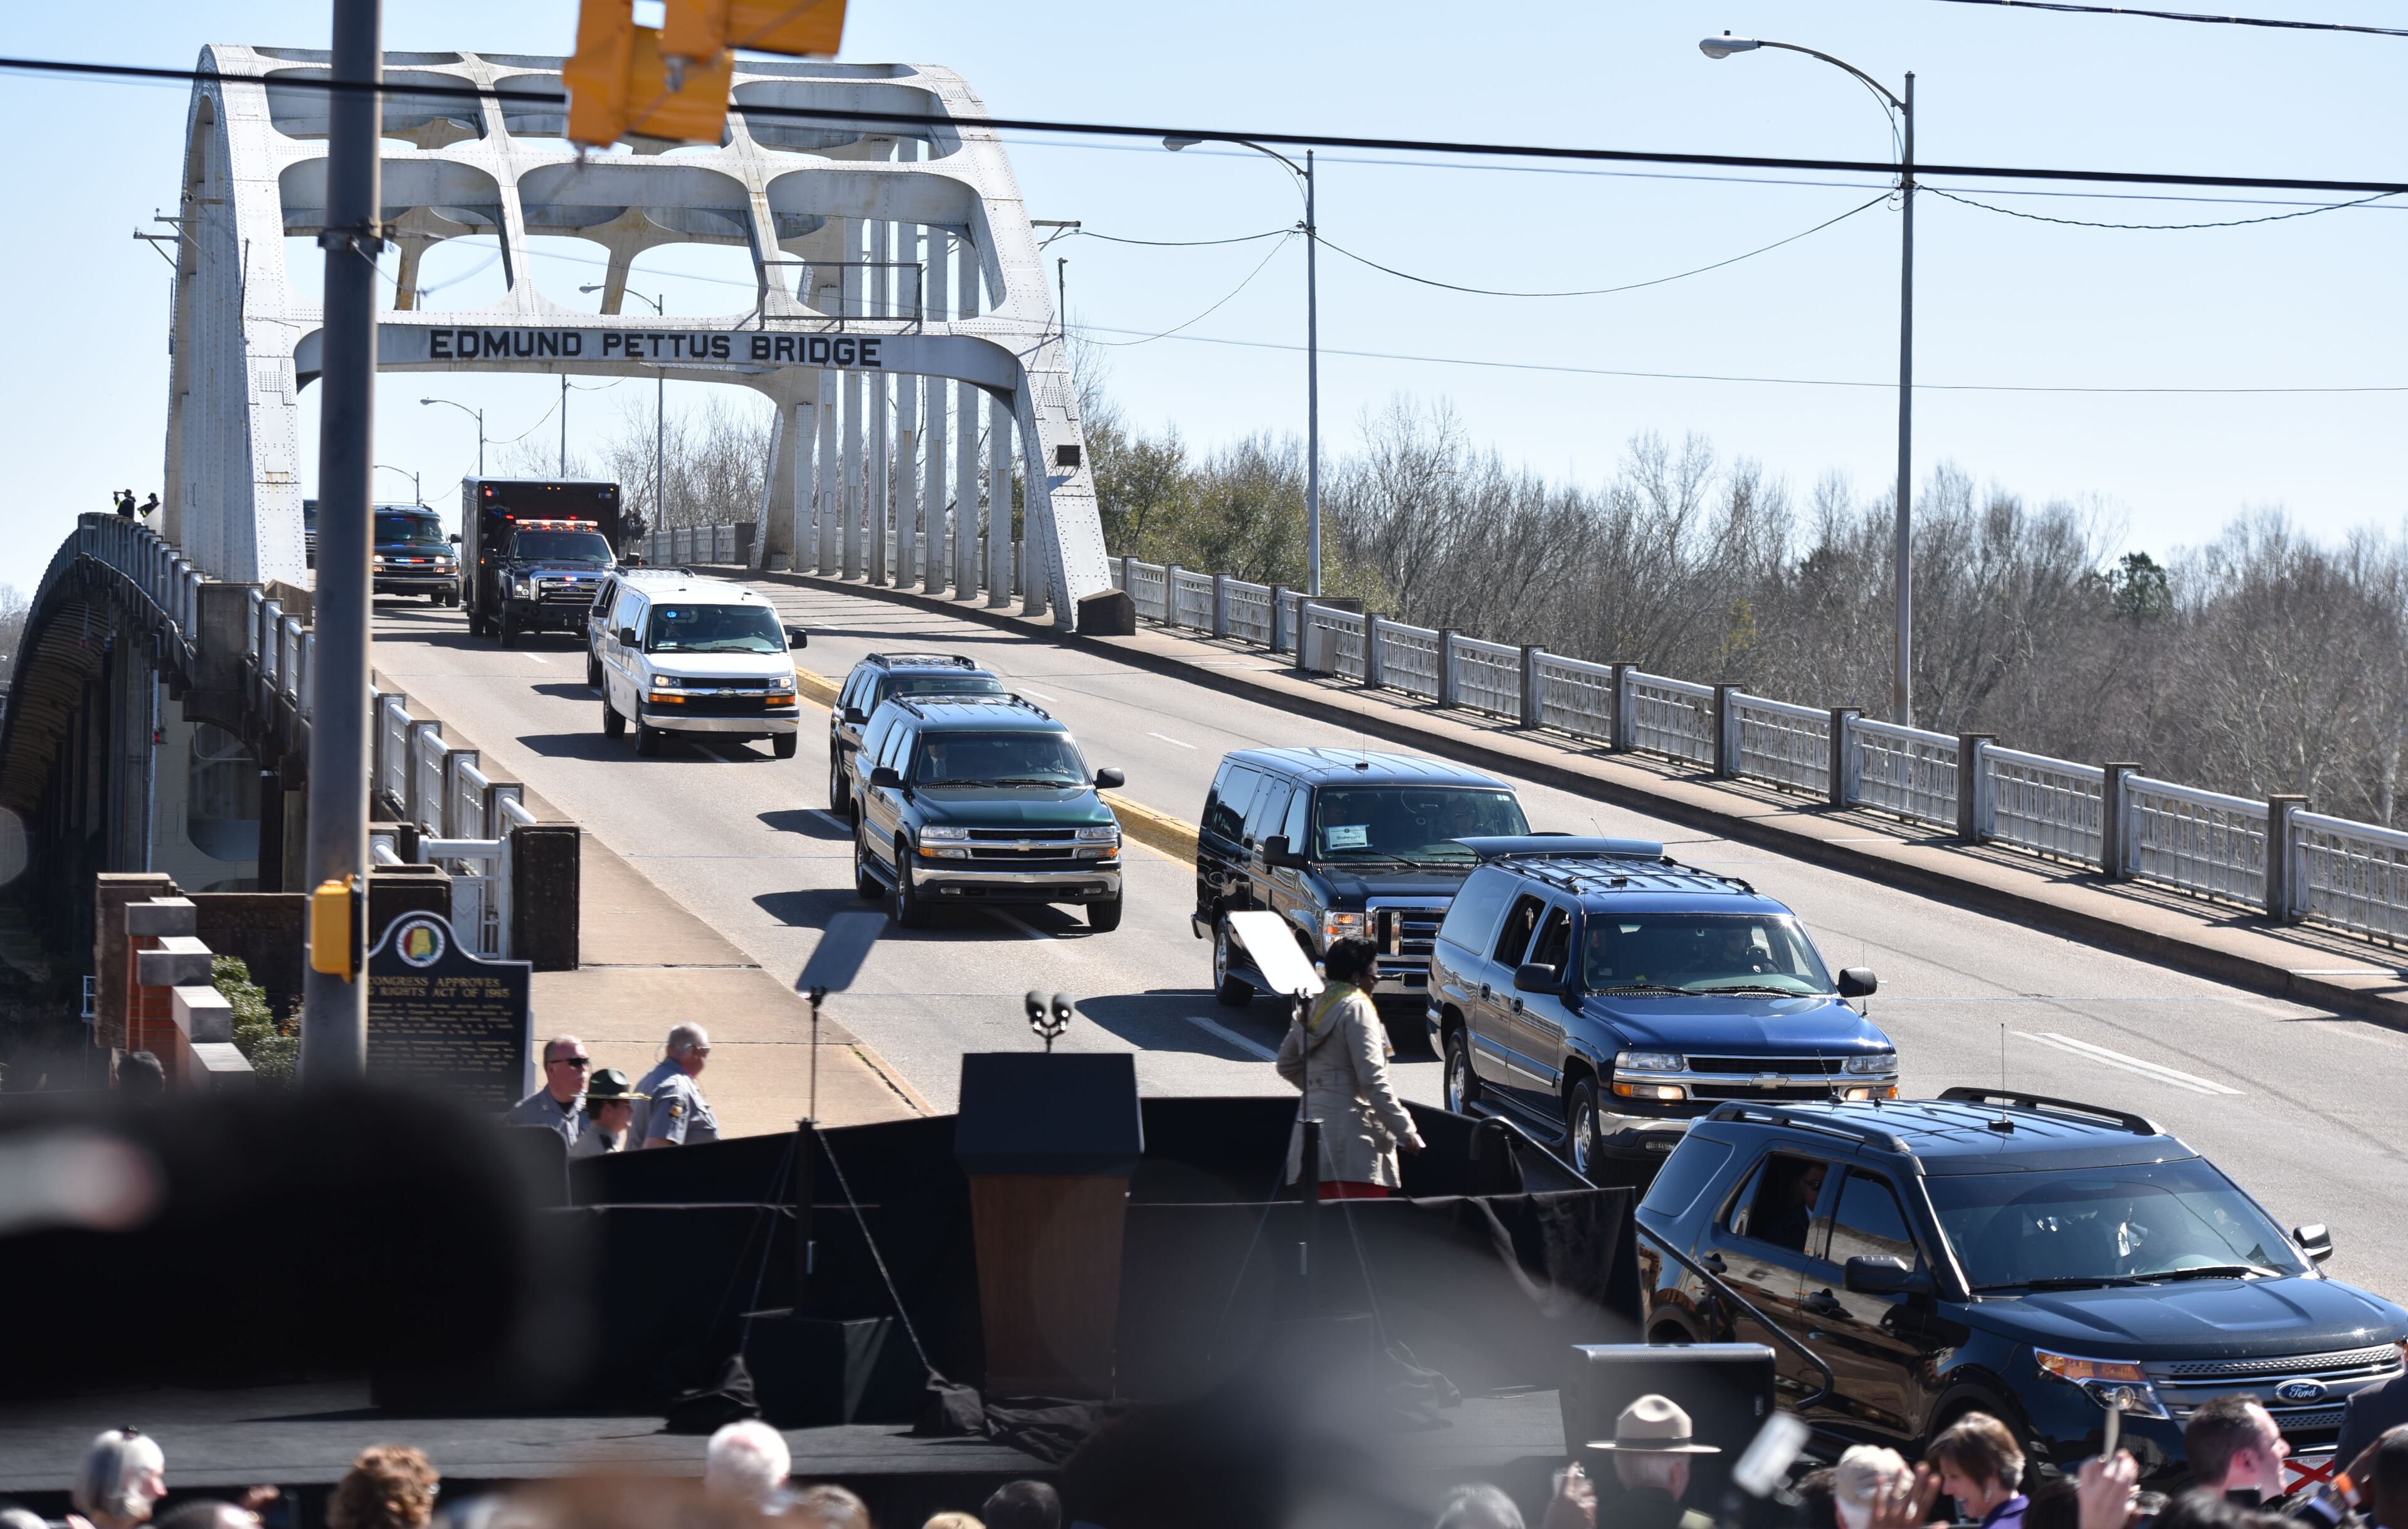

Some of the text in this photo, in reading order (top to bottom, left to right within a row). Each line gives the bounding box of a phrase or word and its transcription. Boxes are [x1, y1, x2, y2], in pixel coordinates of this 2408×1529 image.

[430, 330, 882, 367] EDMUND PETTUS BRIDGE
[436, 977, 500, 987] APPROVES
[379, 987, 426, 997] RIGHTS
[432, 988, 457, 997] ACT
[462, 989, 480, 997] OF
[485, 989, 510, 998] 1965
[2288, 1384, 2318, 1398] Ford
